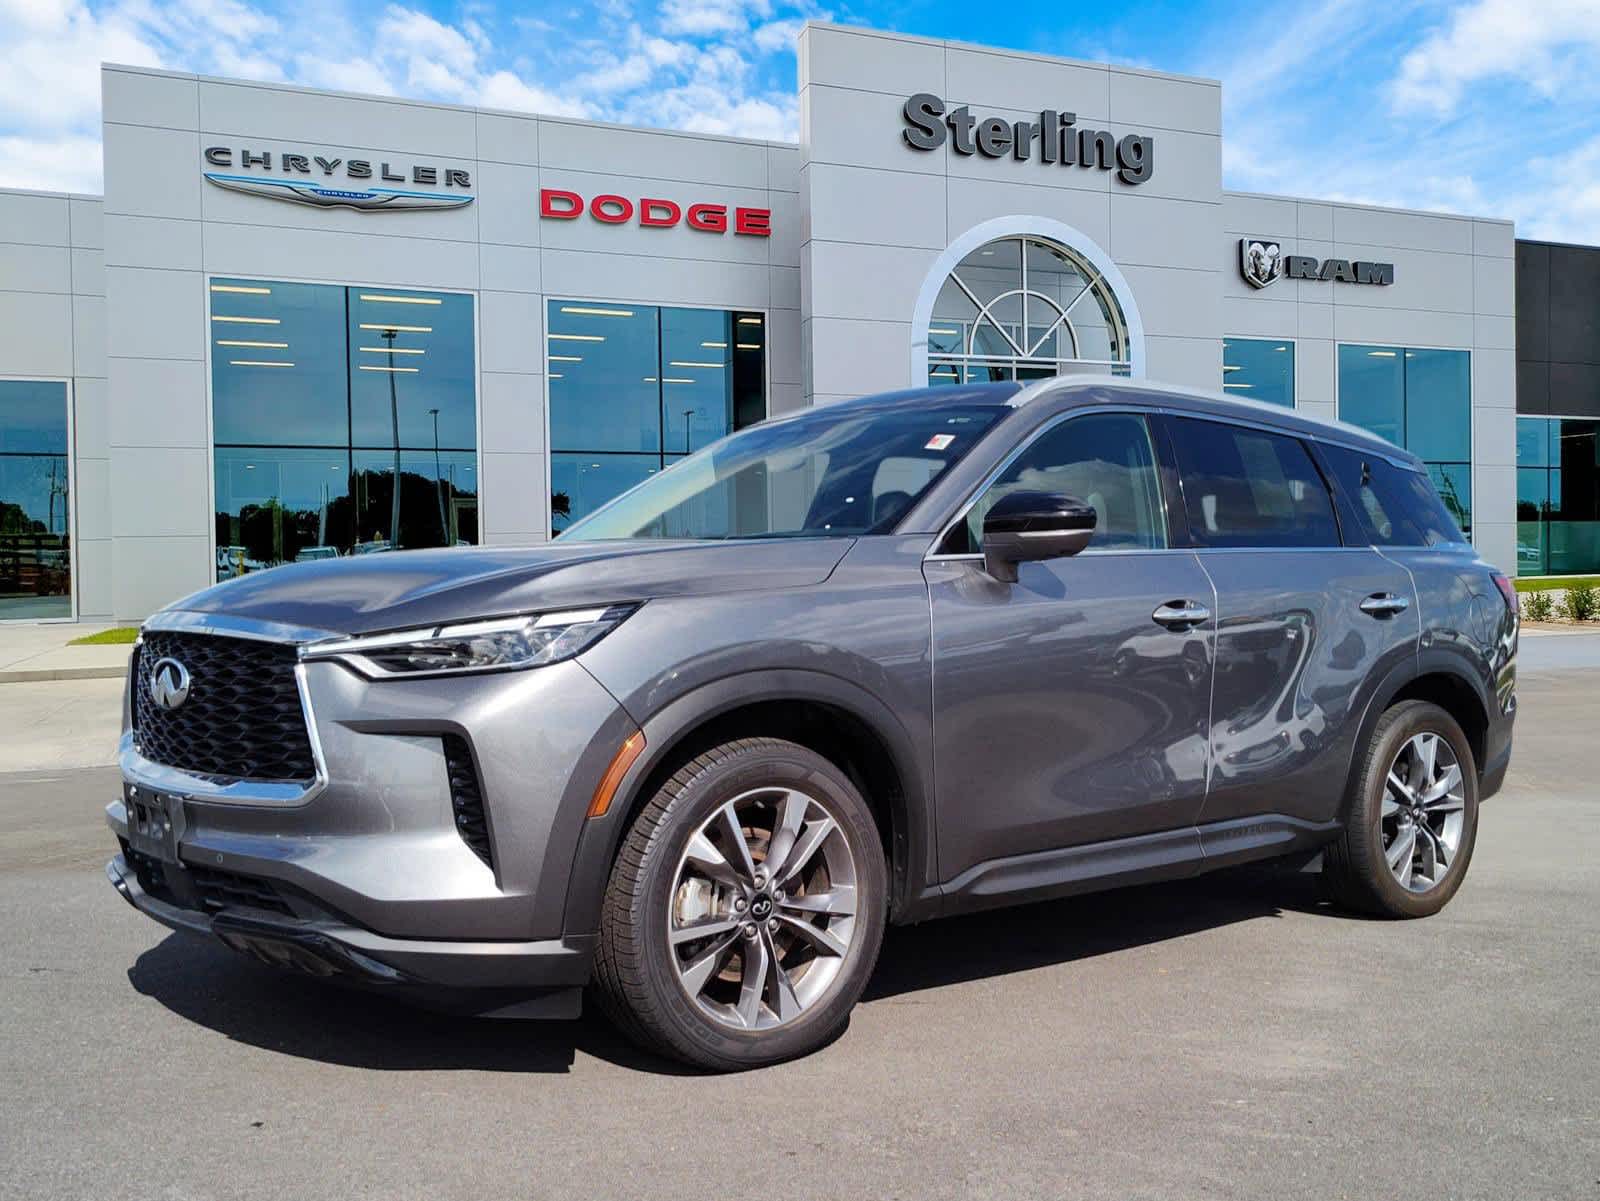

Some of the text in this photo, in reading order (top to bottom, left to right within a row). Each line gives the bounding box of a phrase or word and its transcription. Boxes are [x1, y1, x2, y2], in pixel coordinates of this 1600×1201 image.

[902, 93, 1154, 185] Sterling
[204, 147, 472, 188] CHRYSLER
[540, 189, 772, 237] DODGE
[1284, 255, 1395, 286] RAM
